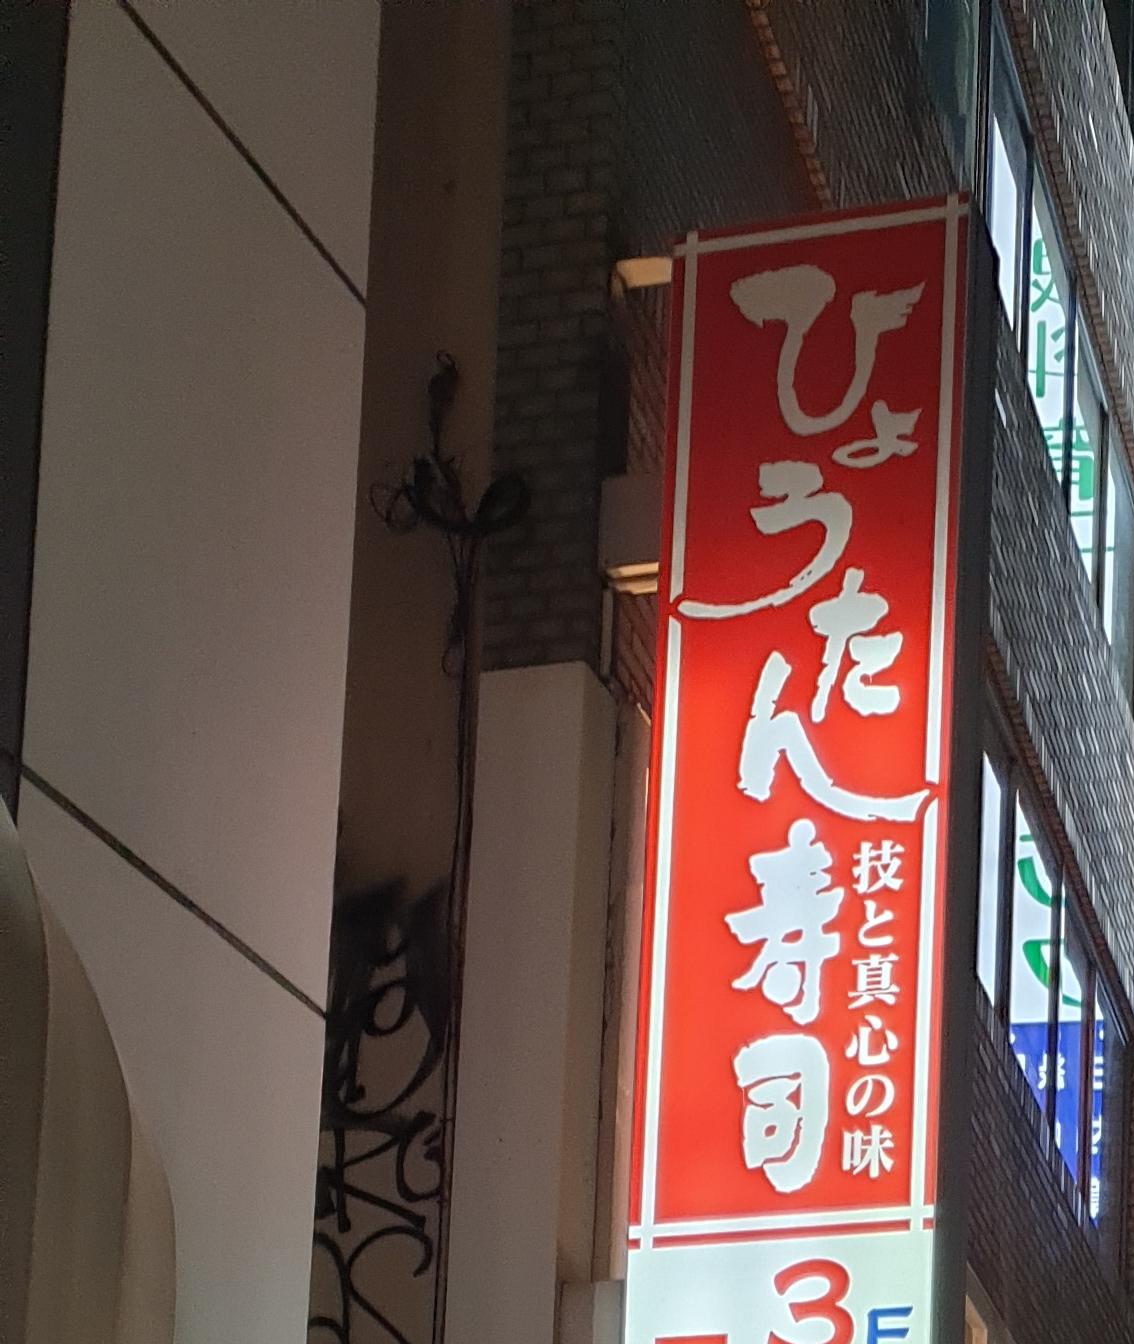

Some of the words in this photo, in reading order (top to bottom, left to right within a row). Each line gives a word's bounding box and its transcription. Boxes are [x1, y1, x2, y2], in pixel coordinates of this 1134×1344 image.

[842, 837, 905, 1179] 技と真心の味
